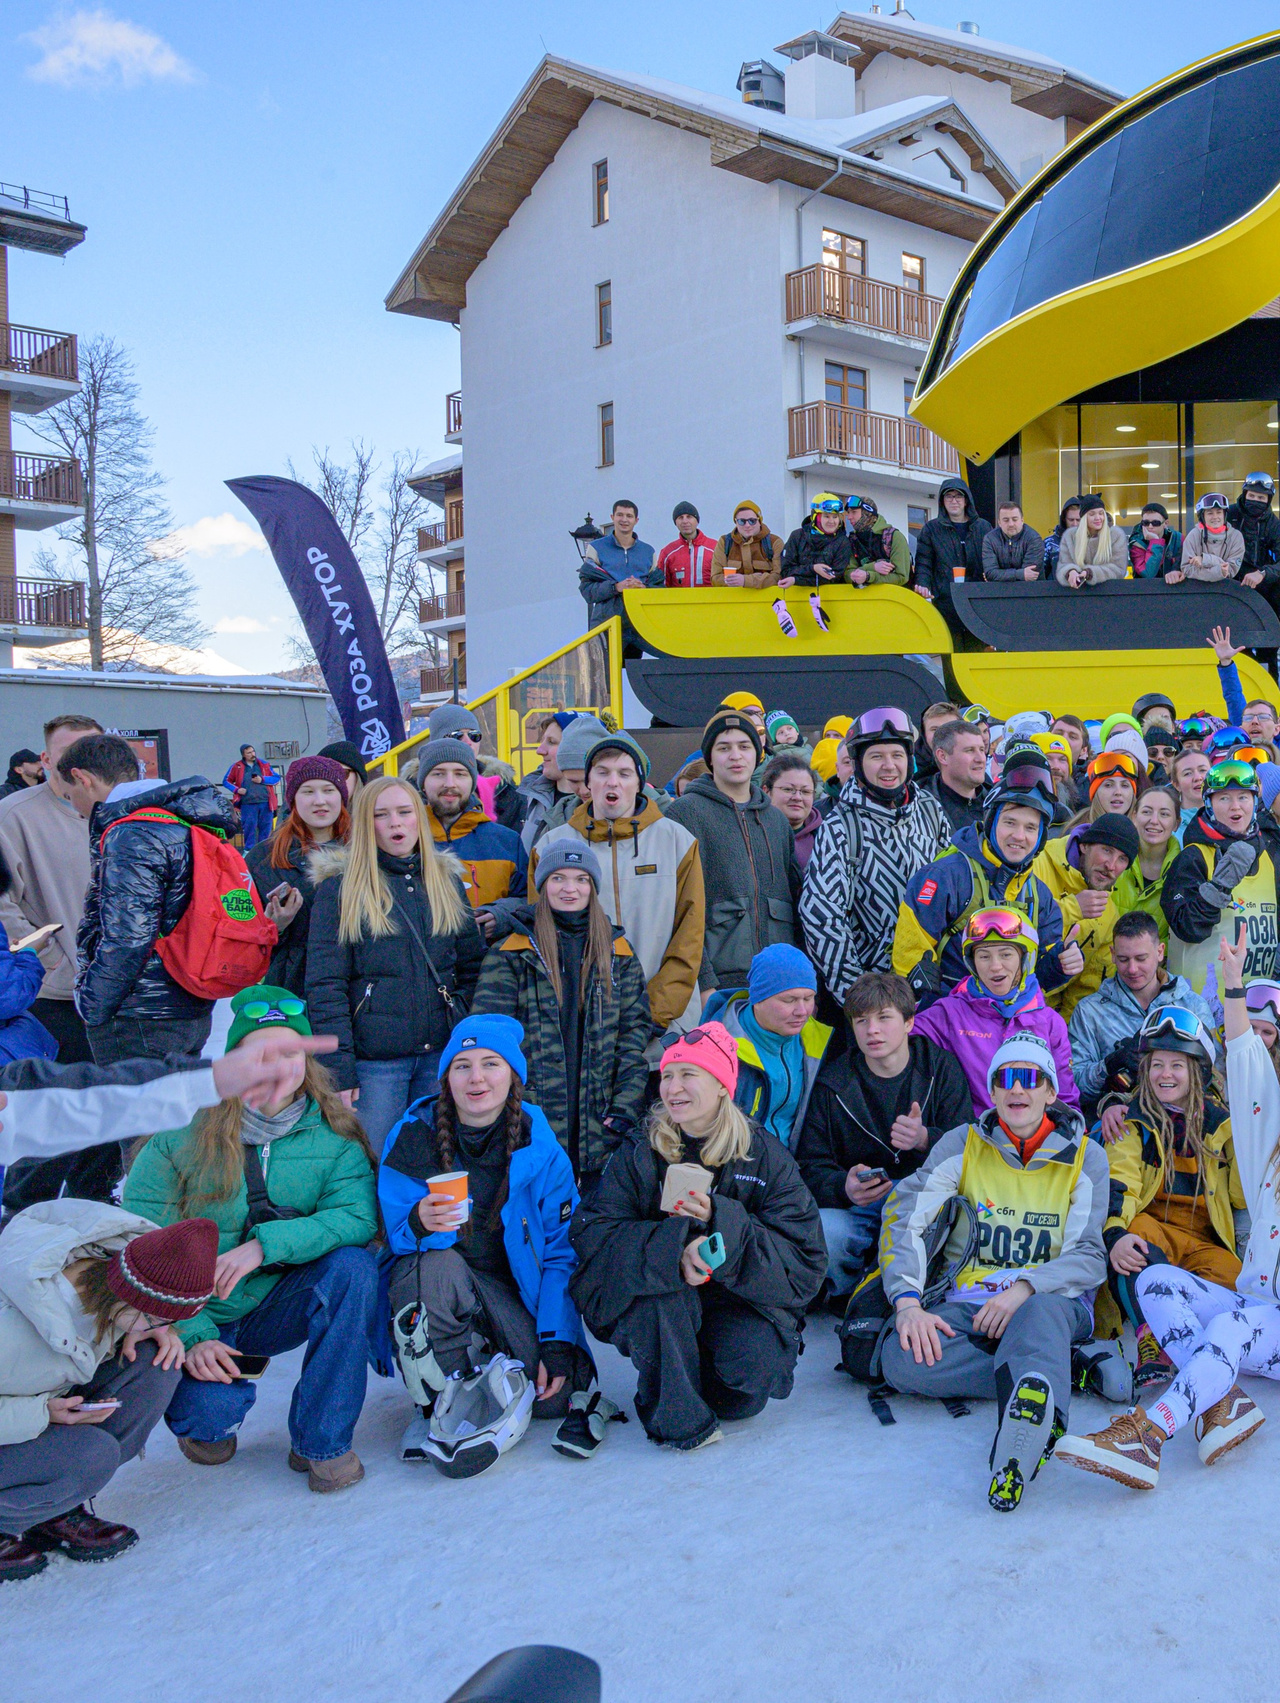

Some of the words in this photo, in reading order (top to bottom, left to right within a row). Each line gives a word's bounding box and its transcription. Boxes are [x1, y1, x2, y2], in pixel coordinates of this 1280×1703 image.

[306, 546, 356, 636] ХУТОР
[347, 636, 379, 712] РОЗА
[226, 904, 255, 914] БАНК
[1245, 901, 1257, 909] сбп
[1234, 915, 1277, 946] РОЗА
[996, 1206, 1016, 1217] сбп
[978, 1221, 1052, 1268] РОЗА
